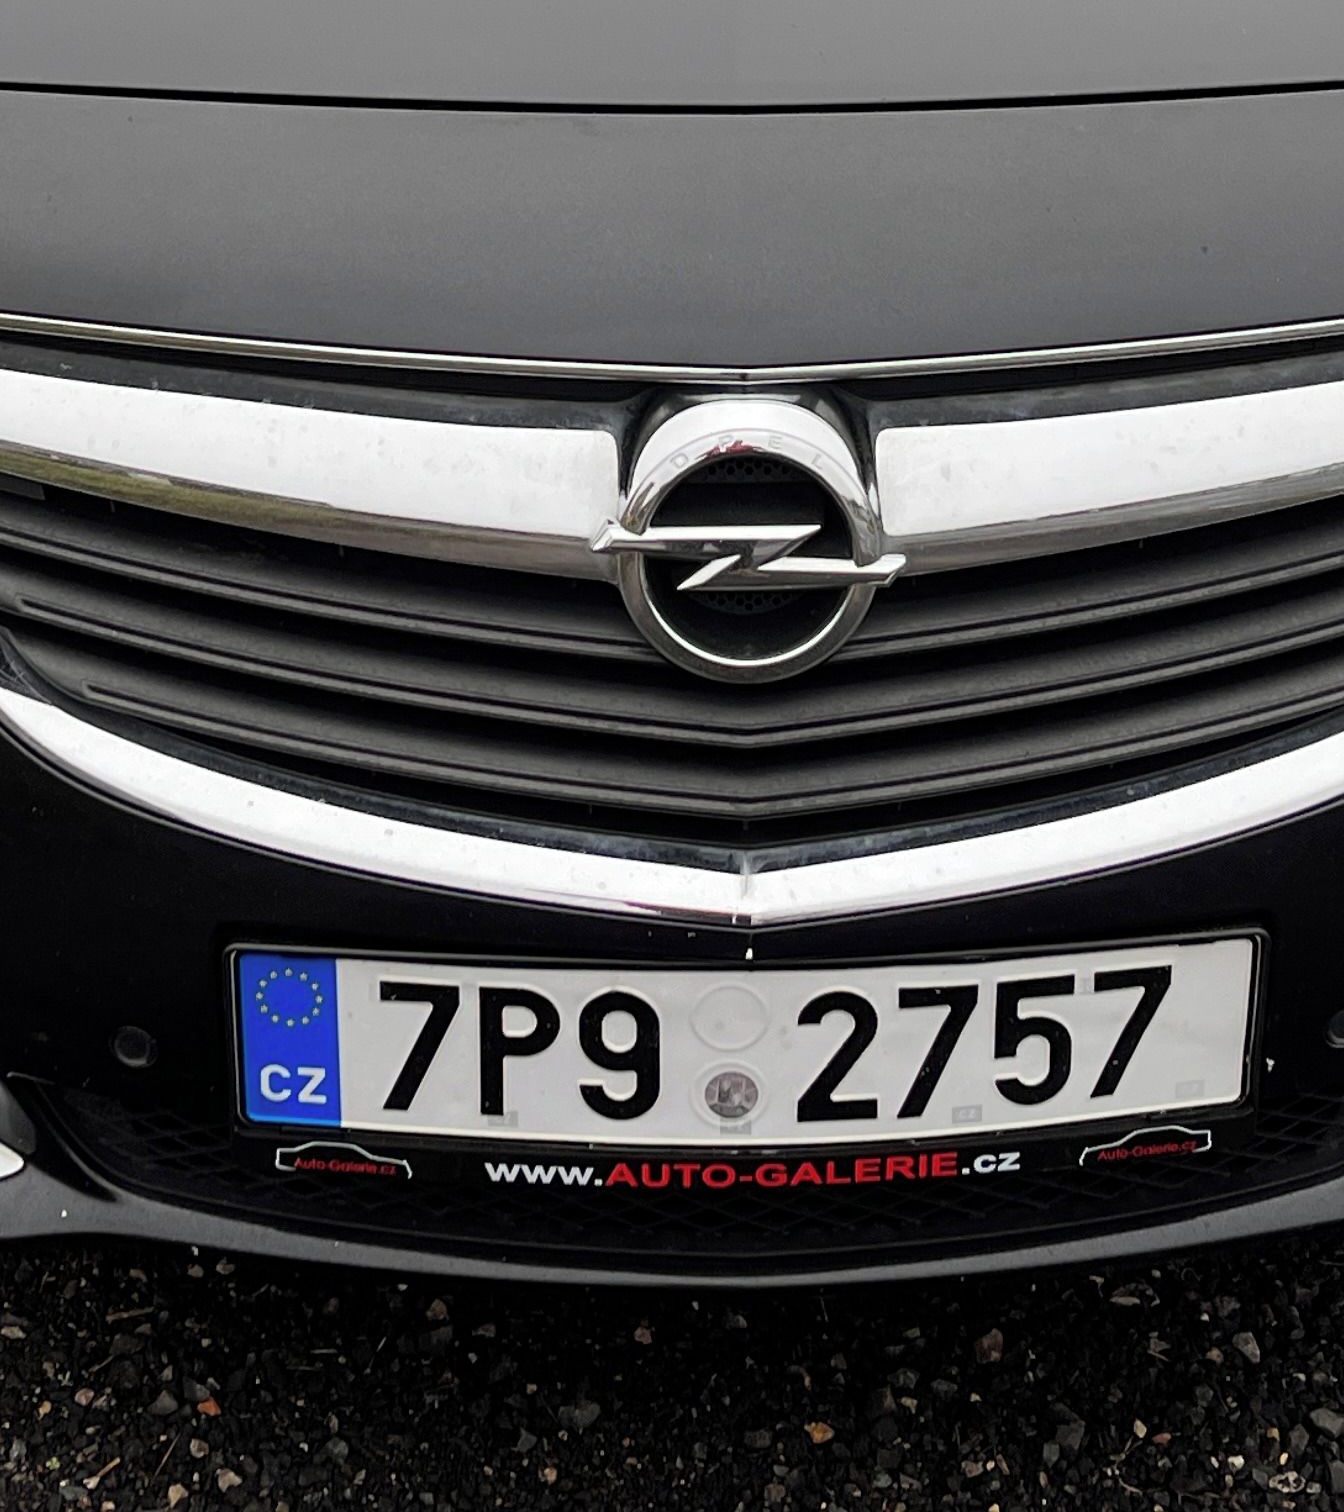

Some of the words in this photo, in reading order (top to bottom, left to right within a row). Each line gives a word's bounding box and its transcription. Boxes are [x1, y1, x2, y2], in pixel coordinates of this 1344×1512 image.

[670, 434, 825, 471] OPEL
[380, 980, 661, 1120] 7P9
[797, 964, 1172, 1122] 2757
[259, 1064, 327, 1104] CZ
[484, 1152, 1021, 1188] www.AUTO-GALERIE.cz
